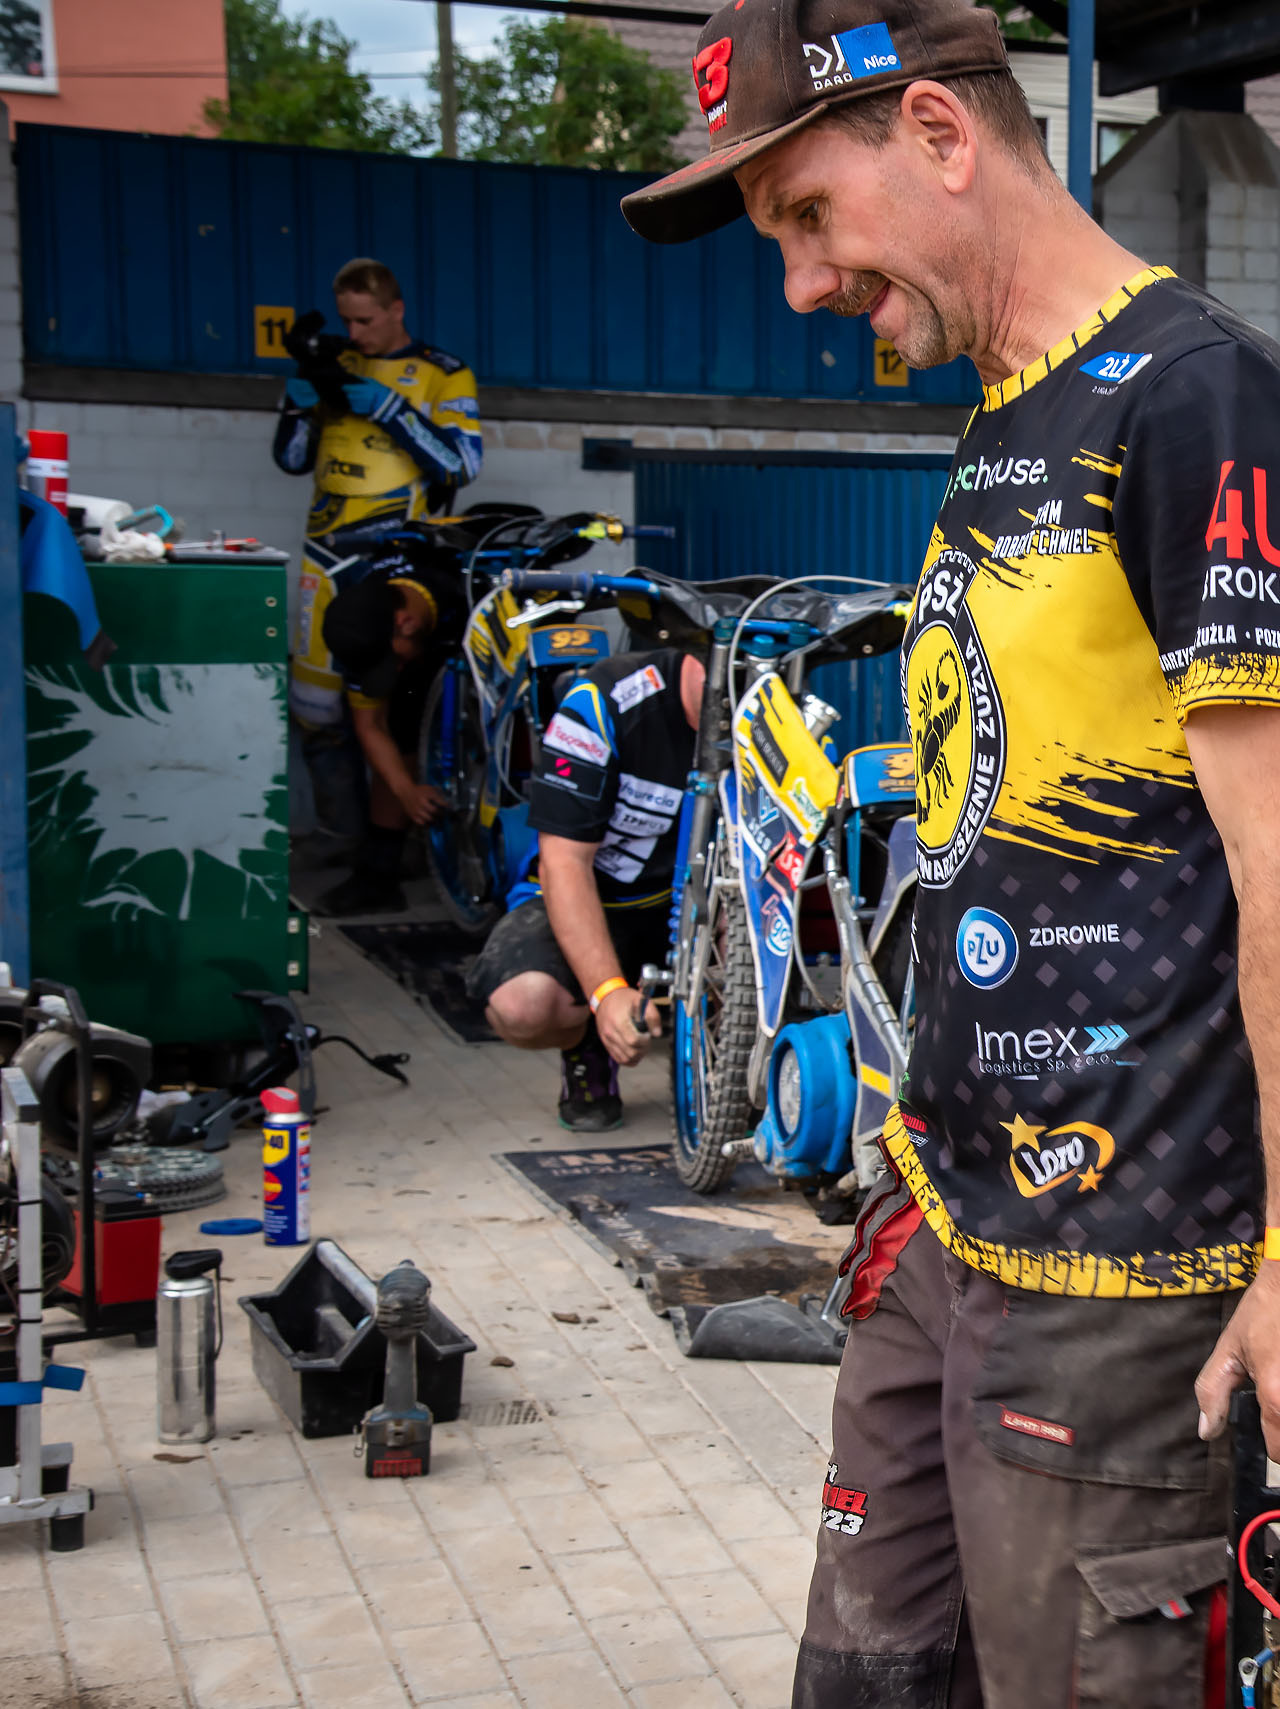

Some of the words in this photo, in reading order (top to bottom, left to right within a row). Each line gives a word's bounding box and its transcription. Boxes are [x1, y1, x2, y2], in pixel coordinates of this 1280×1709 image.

[864, 54, 898, 70] Nice
[1038, 528, 1092, 555] CHMIEL
[918, 570, 964, 624] PSŻ
[967, 932, 999, 965] PZU
[1029, 923, 1120, 947] ZDROWIE
[975, 1021, 1080, 1061] Imex
